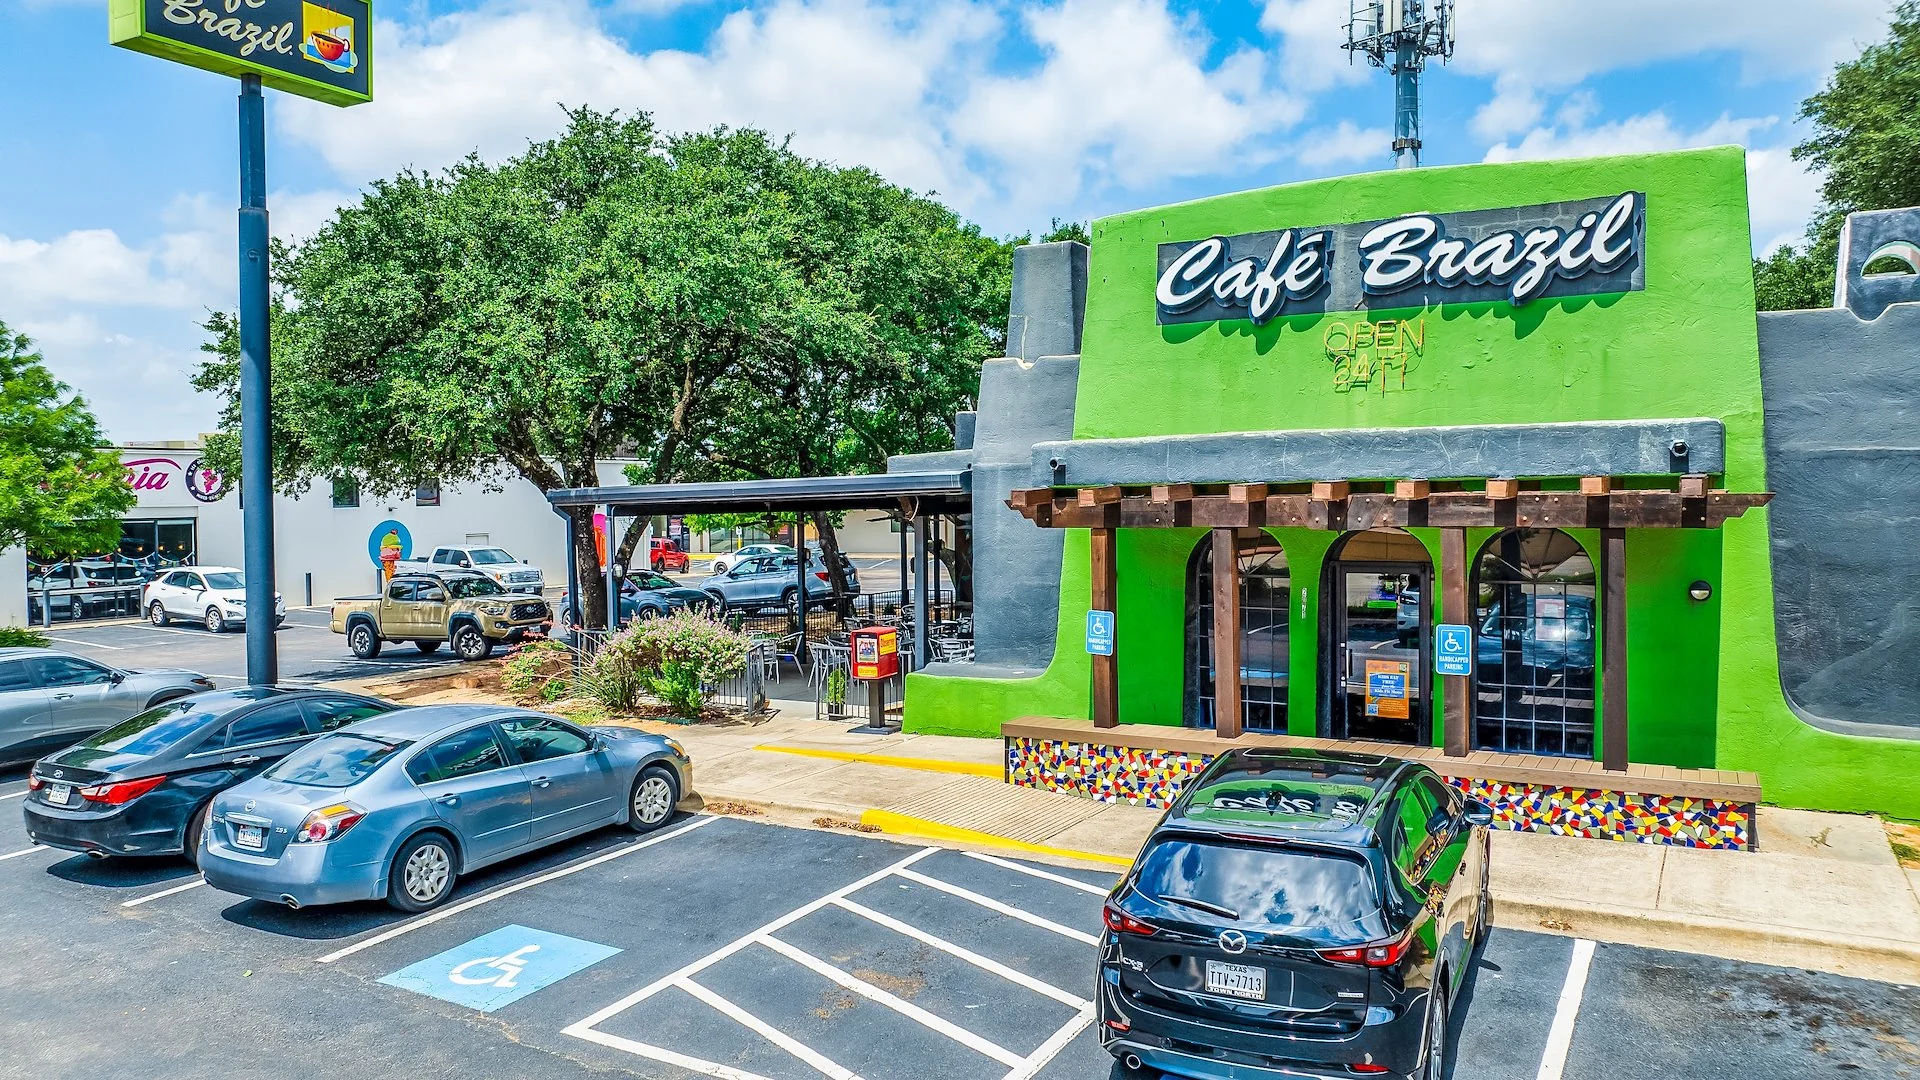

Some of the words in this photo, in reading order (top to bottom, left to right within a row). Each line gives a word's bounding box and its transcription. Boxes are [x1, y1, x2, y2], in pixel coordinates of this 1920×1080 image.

[1359, 191, 1635, 299] Brazil
[1323, 318, 1425, 353] OPEN
[1438, 655, 1469, 664] HANDICAPPED
[1443, 663, 1464, 671] PARKING
[1225, 964, 1248, 973] TEXAS
[1209, 986, 1231, 995] TOWN
[1232, 989, 1264, 1000] NORTH
